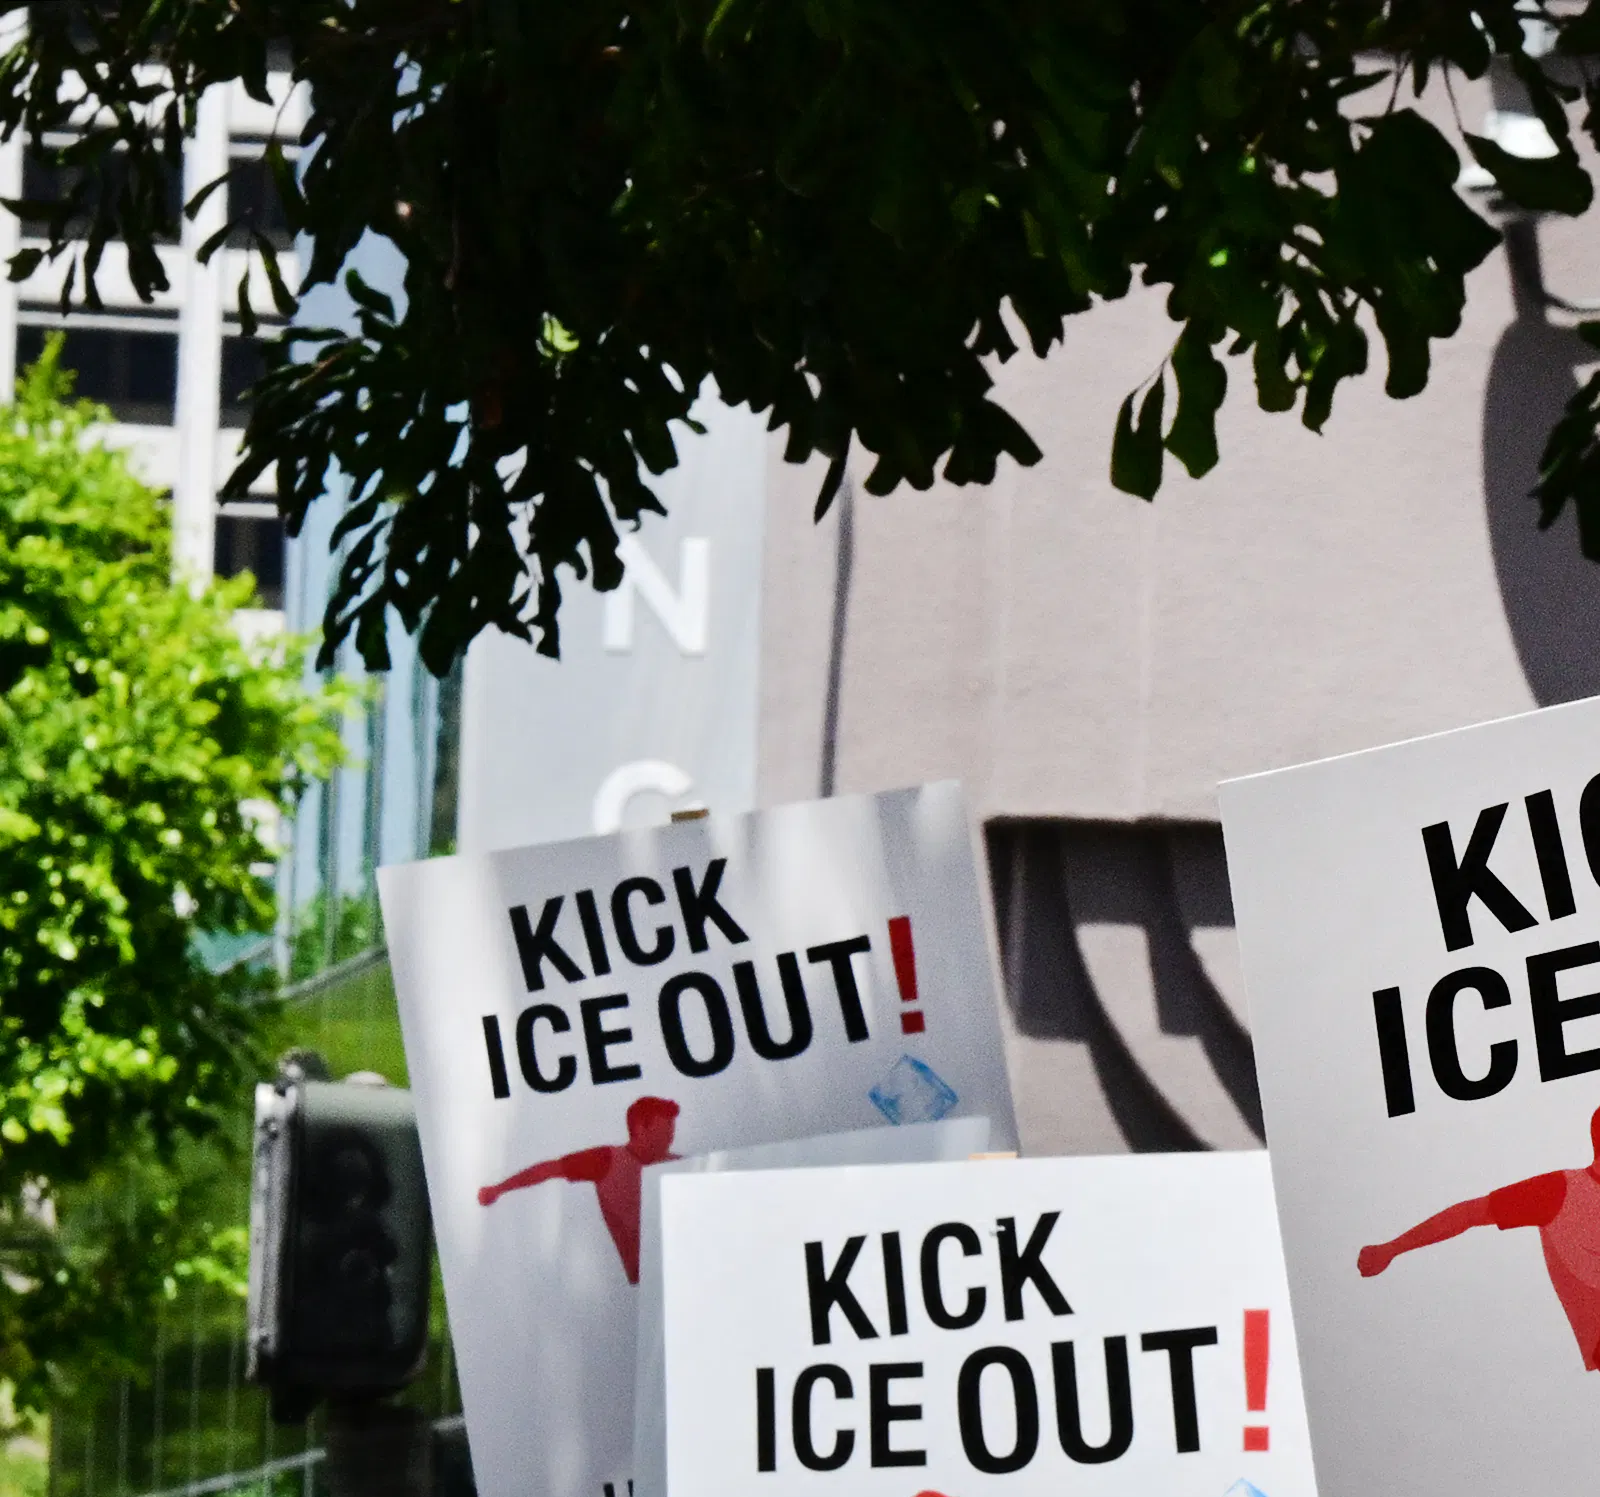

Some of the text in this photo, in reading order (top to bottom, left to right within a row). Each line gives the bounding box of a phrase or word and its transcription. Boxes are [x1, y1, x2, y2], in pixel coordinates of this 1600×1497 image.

[509, 859, 749, 992] KICK
[483, 918, 923, 1098] ICE OUT!
[805, 1212, 1073, 1345] KICK
[757, 1310, 1269, 1474] ICE OUT!
